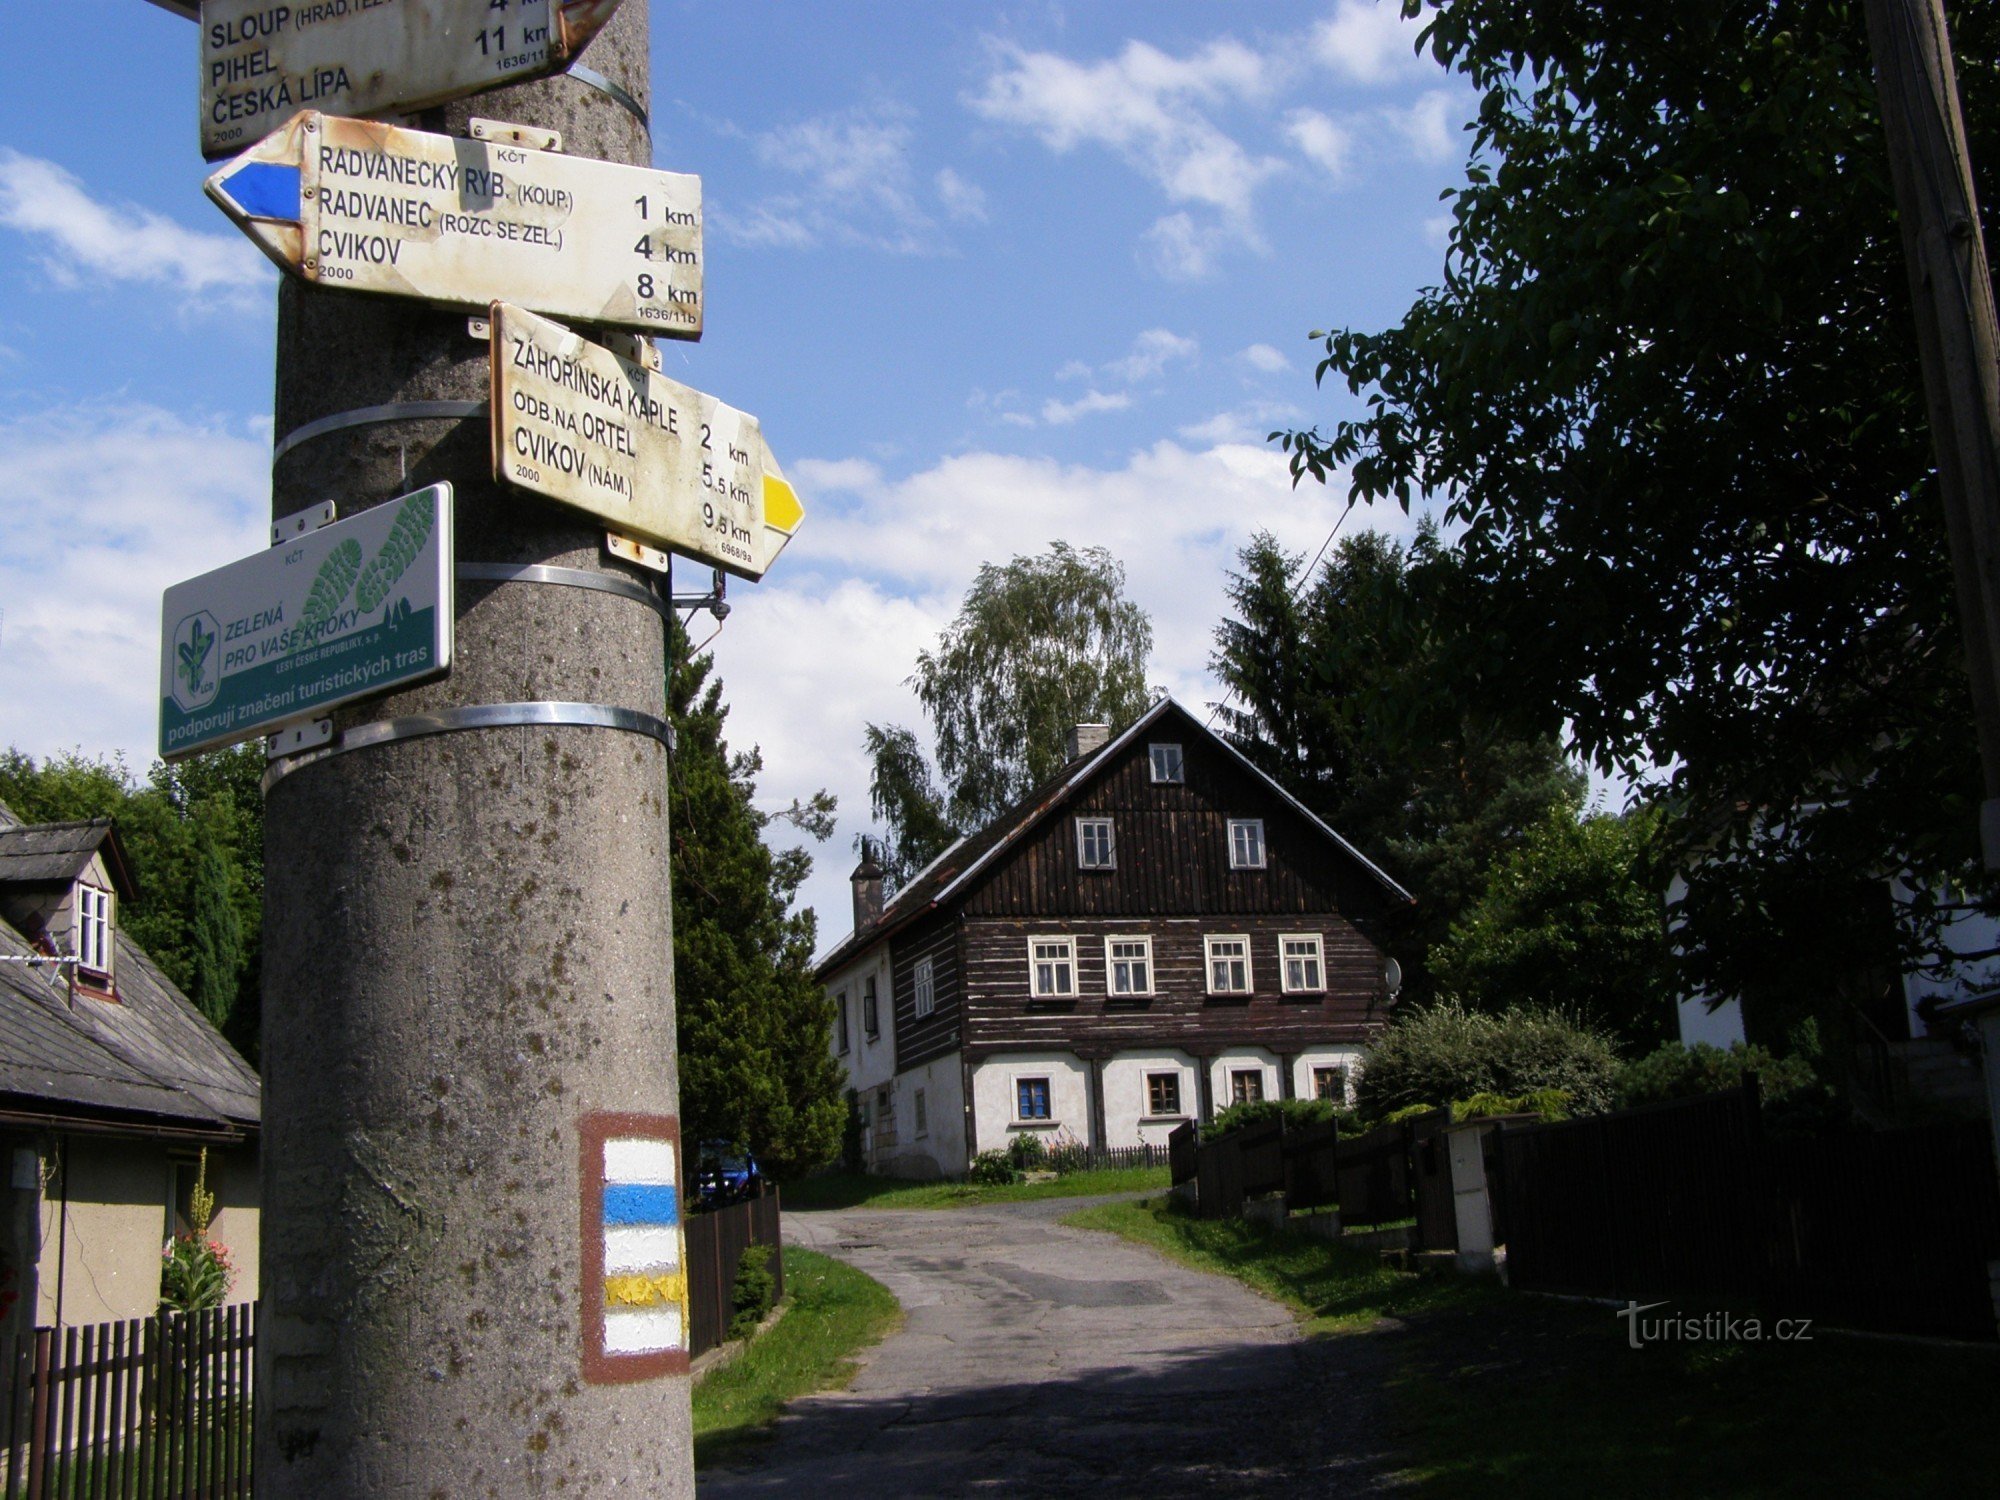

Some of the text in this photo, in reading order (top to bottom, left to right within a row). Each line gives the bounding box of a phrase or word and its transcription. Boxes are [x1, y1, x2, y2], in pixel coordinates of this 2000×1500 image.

[211, 8, 290, 50] SLOUP
[212, 49, 278, 87] PIHEL
[475, 26, 504, 55] 11
[213, 66, 351, 125] ČESKÁ LÍPA
[213, 127, 243, 144] 2000
[497, 148, 527, 165] KČT
[320, 146, 696, 226] RADVANECKÝ RYB. (KOUP.) 1 km
[320, 187, 697, 265] RADVANEC (ROZC SE ZEL.) 4 km
[318, 265, 354, 281] 2000
[319, 230, 698, 305] CVIKOV 8 km
[637, 306, 697, 324] 1636/11b
[627, 366, 647, 385] KČT
[514, 338, 749, 466] ZÁHOŘÍNSKÁ KAPLE 2 km
[516, 464, 540, 483] 2000
[582, 412, 635, 458] ORTEL
[702, 463, 726, 495] 5.5
[730, 481, 750, 505] km
[515, 427, 751, 545] CVIKOV (NÁM.) 9.5 km
[285, 550, 304, 566] KČT
[721, 542, 752, 563] 6968/9a
[225, 602, 283, 642] ZELENÁ
[225, 607, 361, 670] PRO VAŠE KROKY
[276, 660, 294, 674] LESY
[295, 649, 319, 667] ČESKÉ
[168, 646, 428, 745] podporují značení turistických tras
